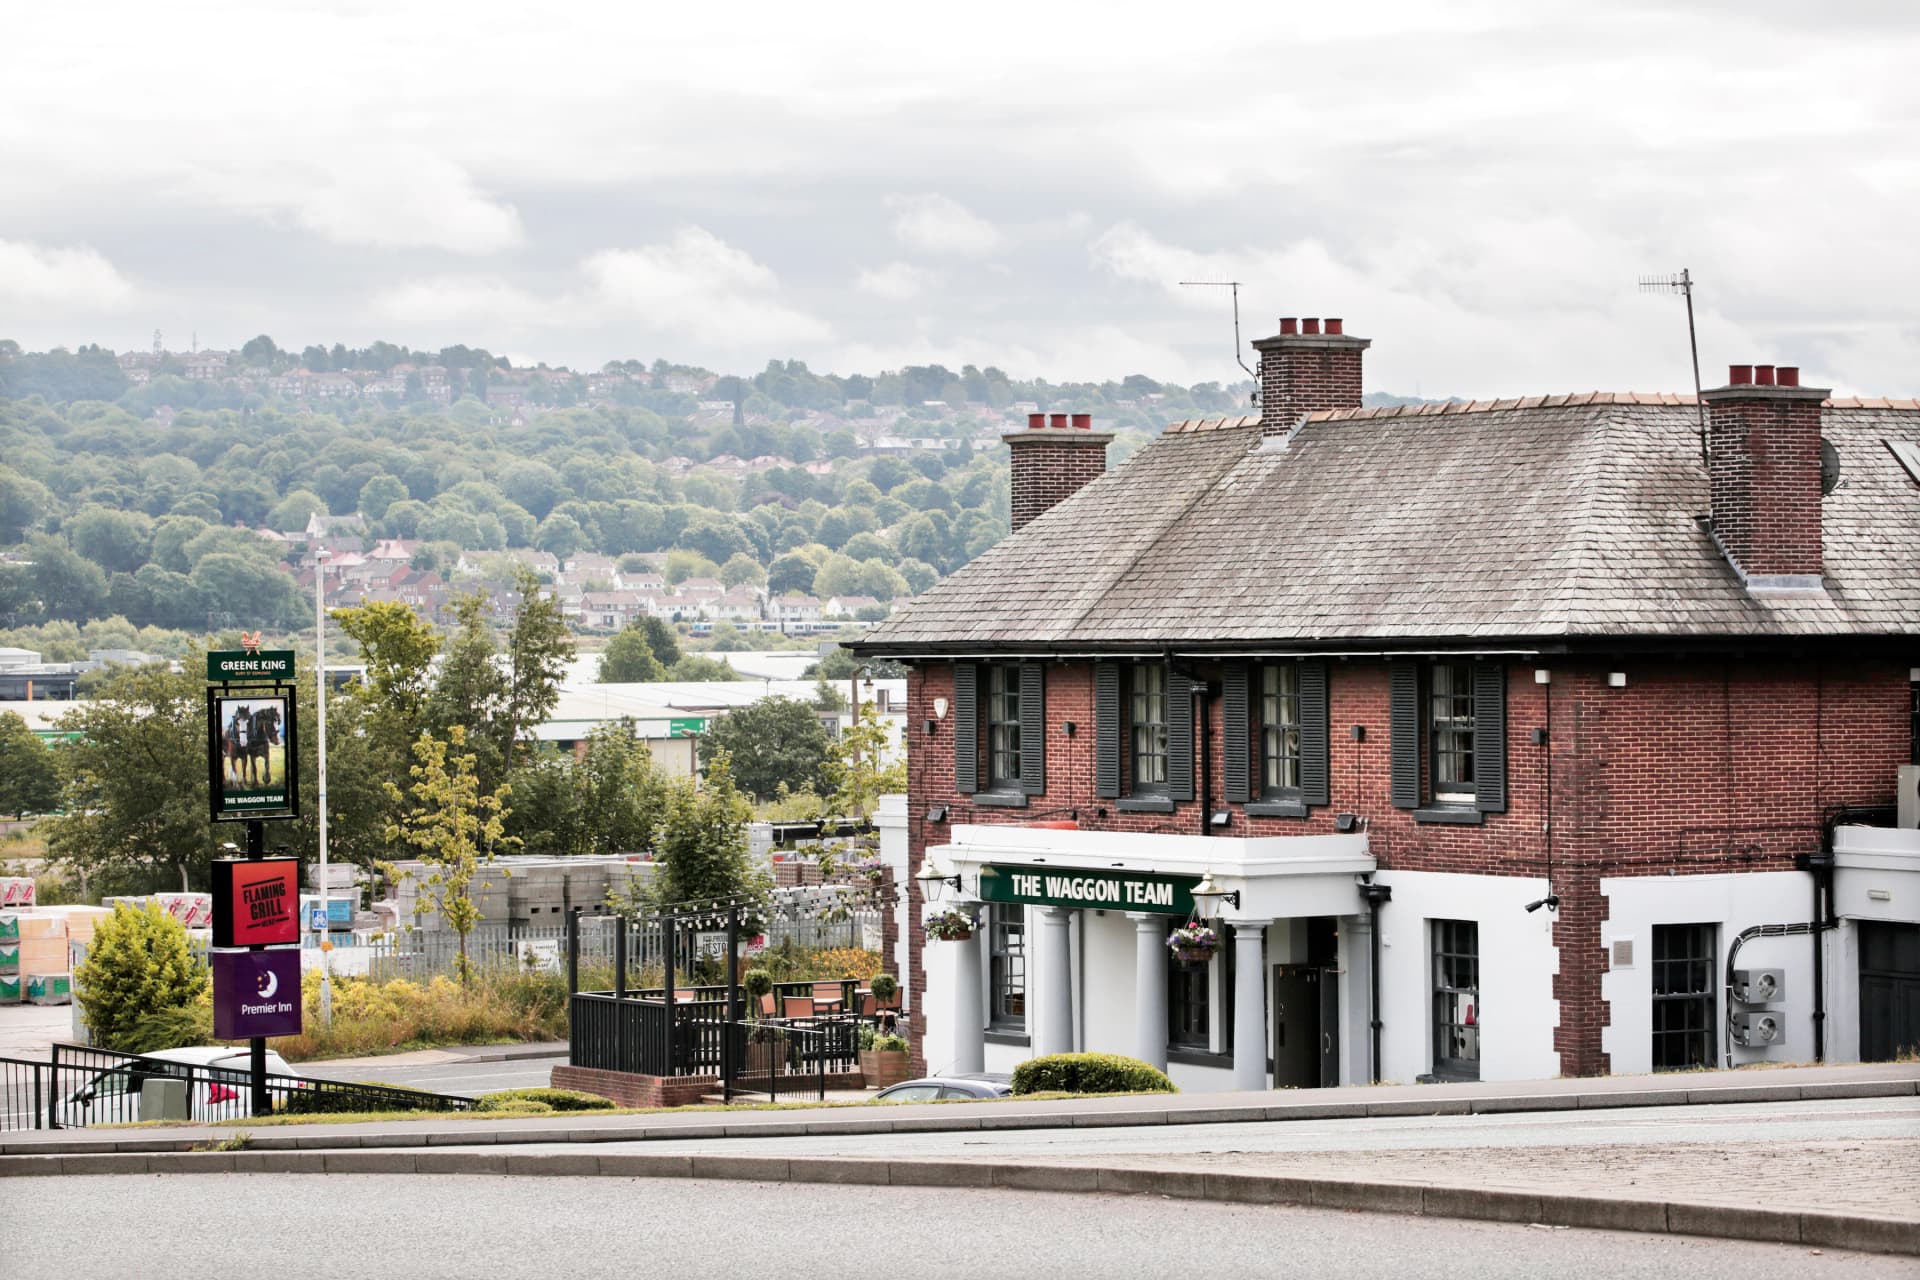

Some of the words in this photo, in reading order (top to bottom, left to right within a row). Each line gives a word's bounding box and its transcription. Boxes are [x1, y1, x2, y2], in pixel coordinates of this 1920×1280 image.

[221, 661, 258, 671] GREENE
[261, 660, 286, 670] KING
[237, 796, 266, 804] WAGGON
[243, 882, 286, 905] FLAMING
[1011, 874, 1042, 897] THE
[1045, 876, 1120, 902] WAGGON
[1124, 881, 1174, 906] TEAM
[251, 898, 284, 920] GRILL
[241, 1002, 277, 1015] Premier
[278, 1001, 292, 1012] Inn
